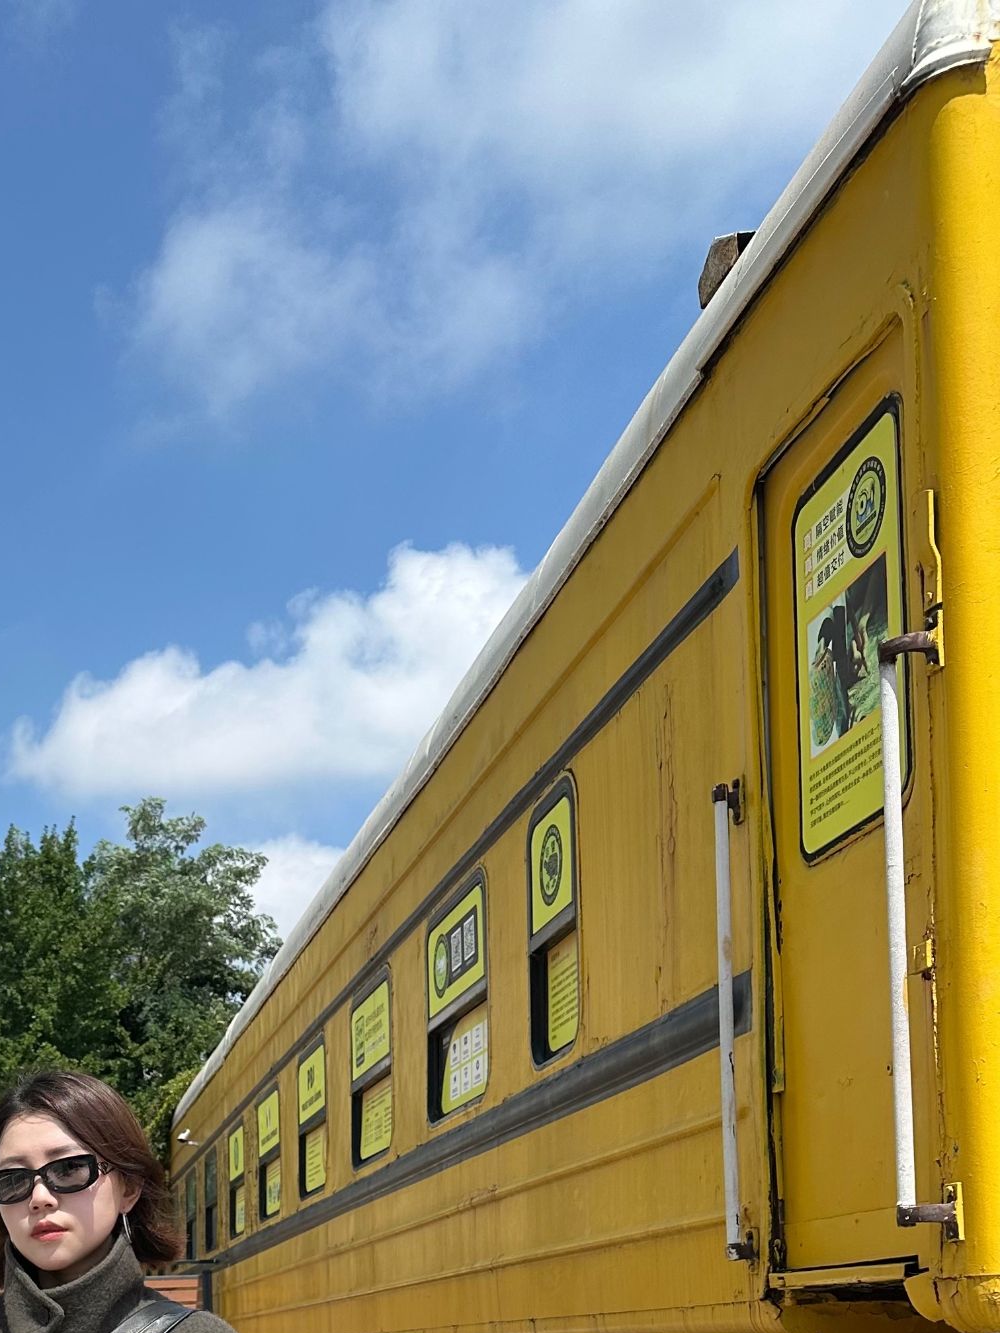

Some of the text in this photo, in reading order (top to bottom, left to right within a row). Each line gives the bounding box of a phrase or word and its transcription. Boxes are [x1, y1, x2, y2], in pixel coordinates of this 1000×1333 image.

[816, 524, 844, 563] 情绪价值
[816, 551, 845, 588] 超值交付
